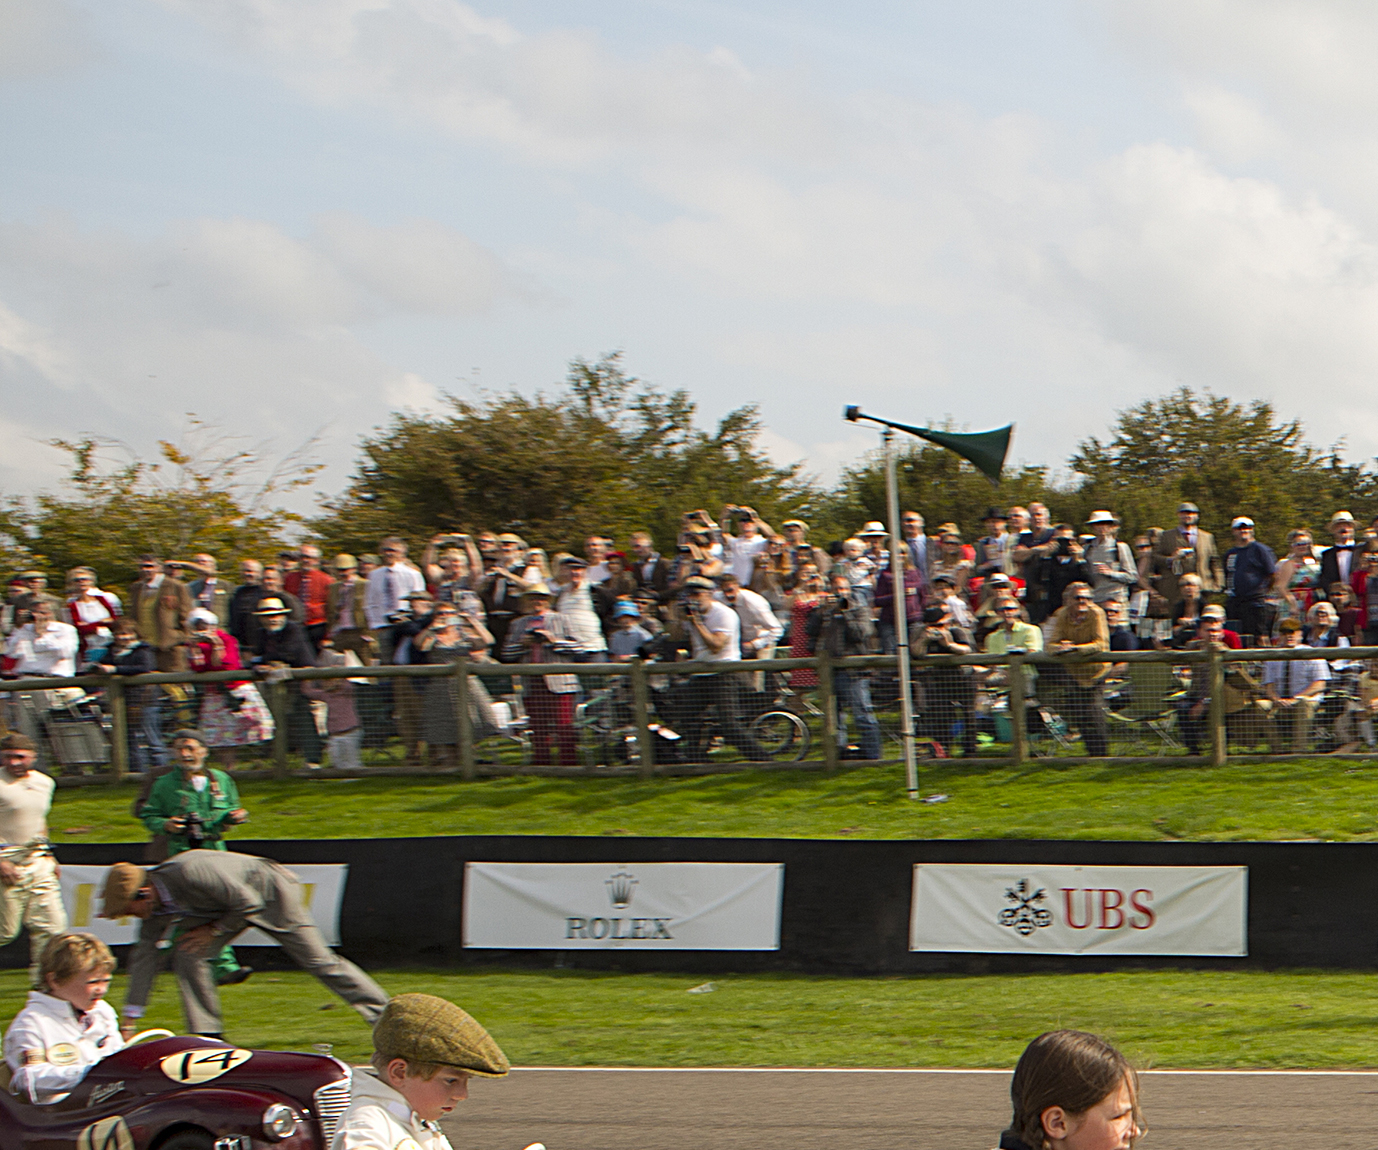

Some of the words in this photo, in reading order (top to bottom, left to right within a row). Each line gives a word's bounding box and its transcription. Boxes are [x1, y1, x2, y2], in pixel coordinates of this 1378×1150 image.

[1058, 888, 1157, 930] UBS
[565, 917, 674, 940] ROLEX
[181, 1050, 240, 1081] 14
